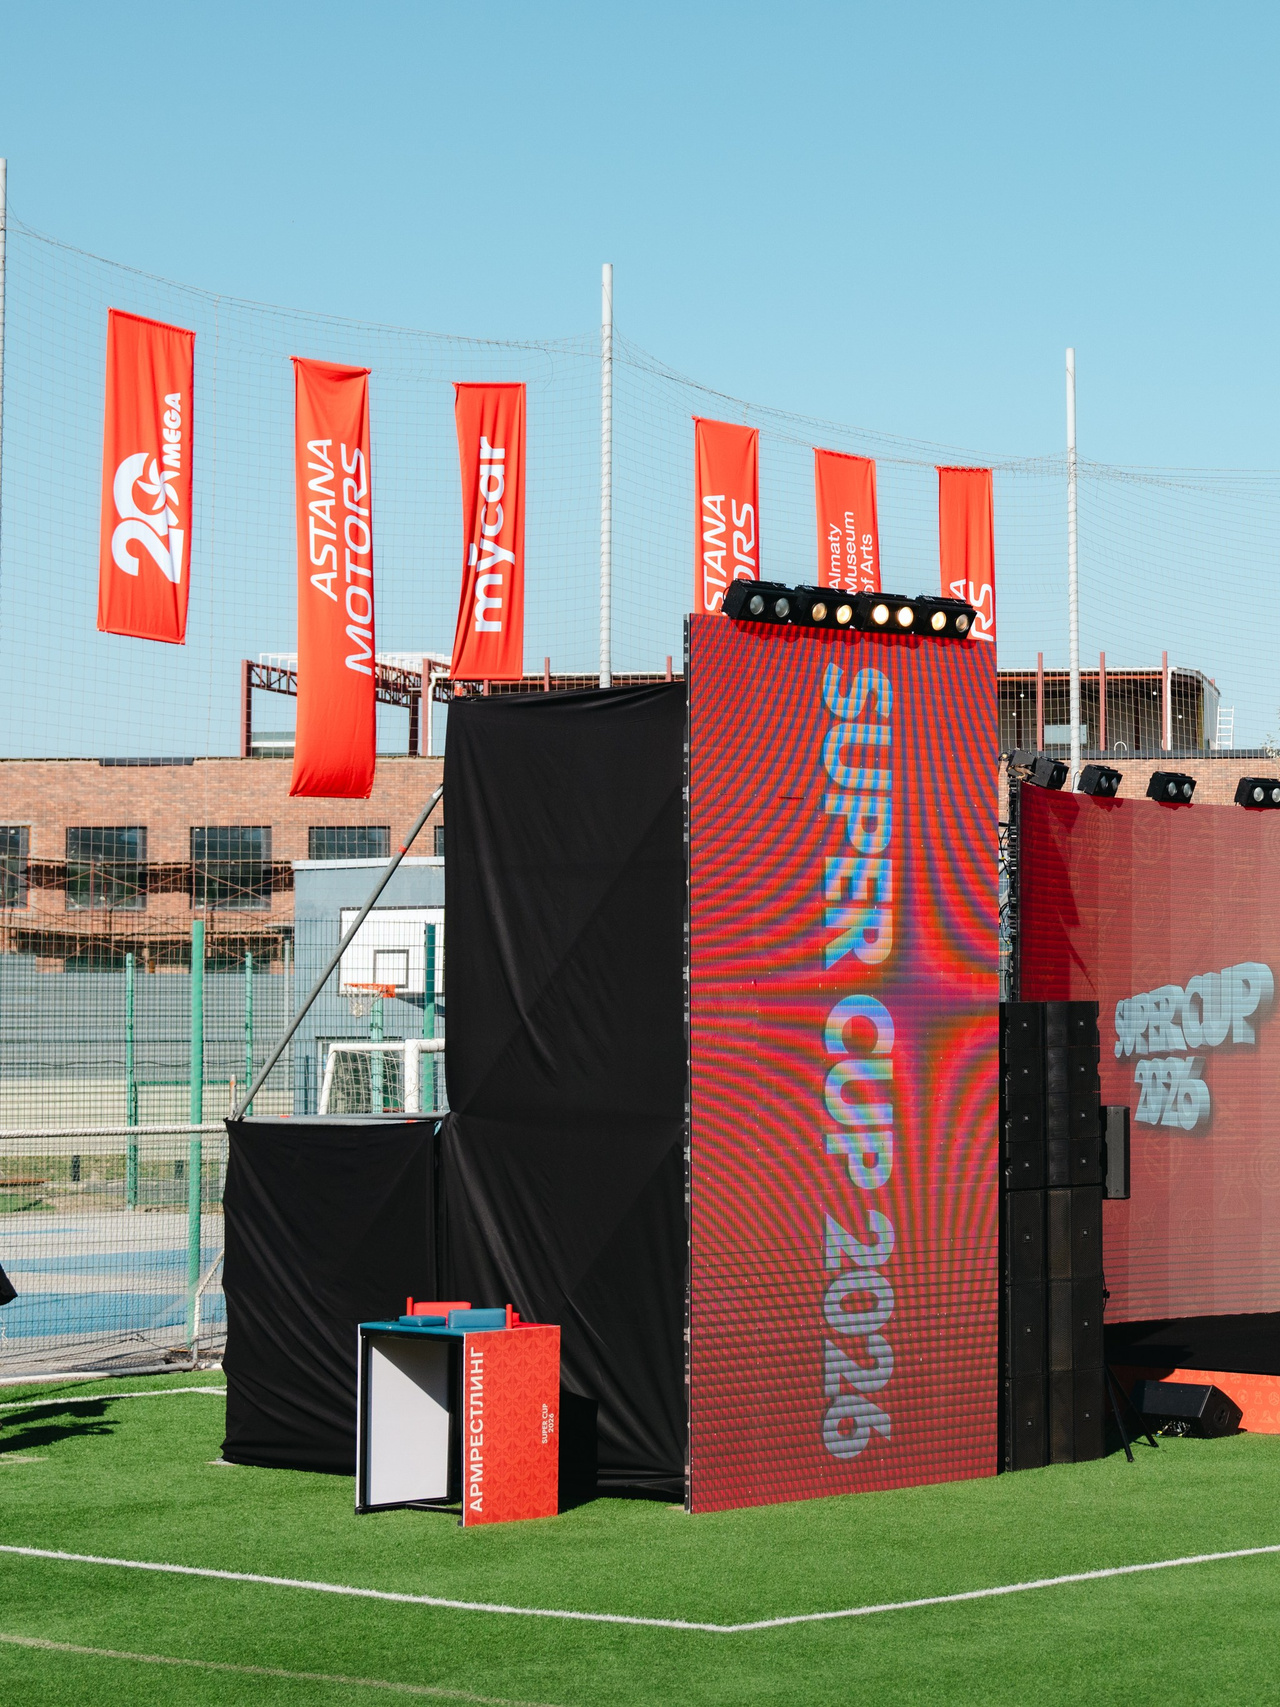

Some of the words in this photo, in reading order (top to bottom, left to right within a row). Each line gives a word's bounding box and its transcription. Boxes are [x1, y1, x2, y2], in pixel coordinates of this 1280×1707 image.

[163, 392, 181, 468] MEGA
[307, 439, 338, 602] ASTANA
[341, 443, 373, 676] MOTORS
[703, 495, 727, 615] STANA
[828, 523, 842, 592] Almaty
[845, 511, 857, 595] Museum
[860, 534, 874, 575] Arts
[823, 662, 892, 970] SUPER
[1182, 961, 1275, 1048] CUP
[824, 994, 895, 1189] CUP
[1134, 1056, 1211, 1131] 2026
[823, 1210, 895, 1458] 2026
[469, 1347, 484, 1512] АРМРЕСТЛИНГ
